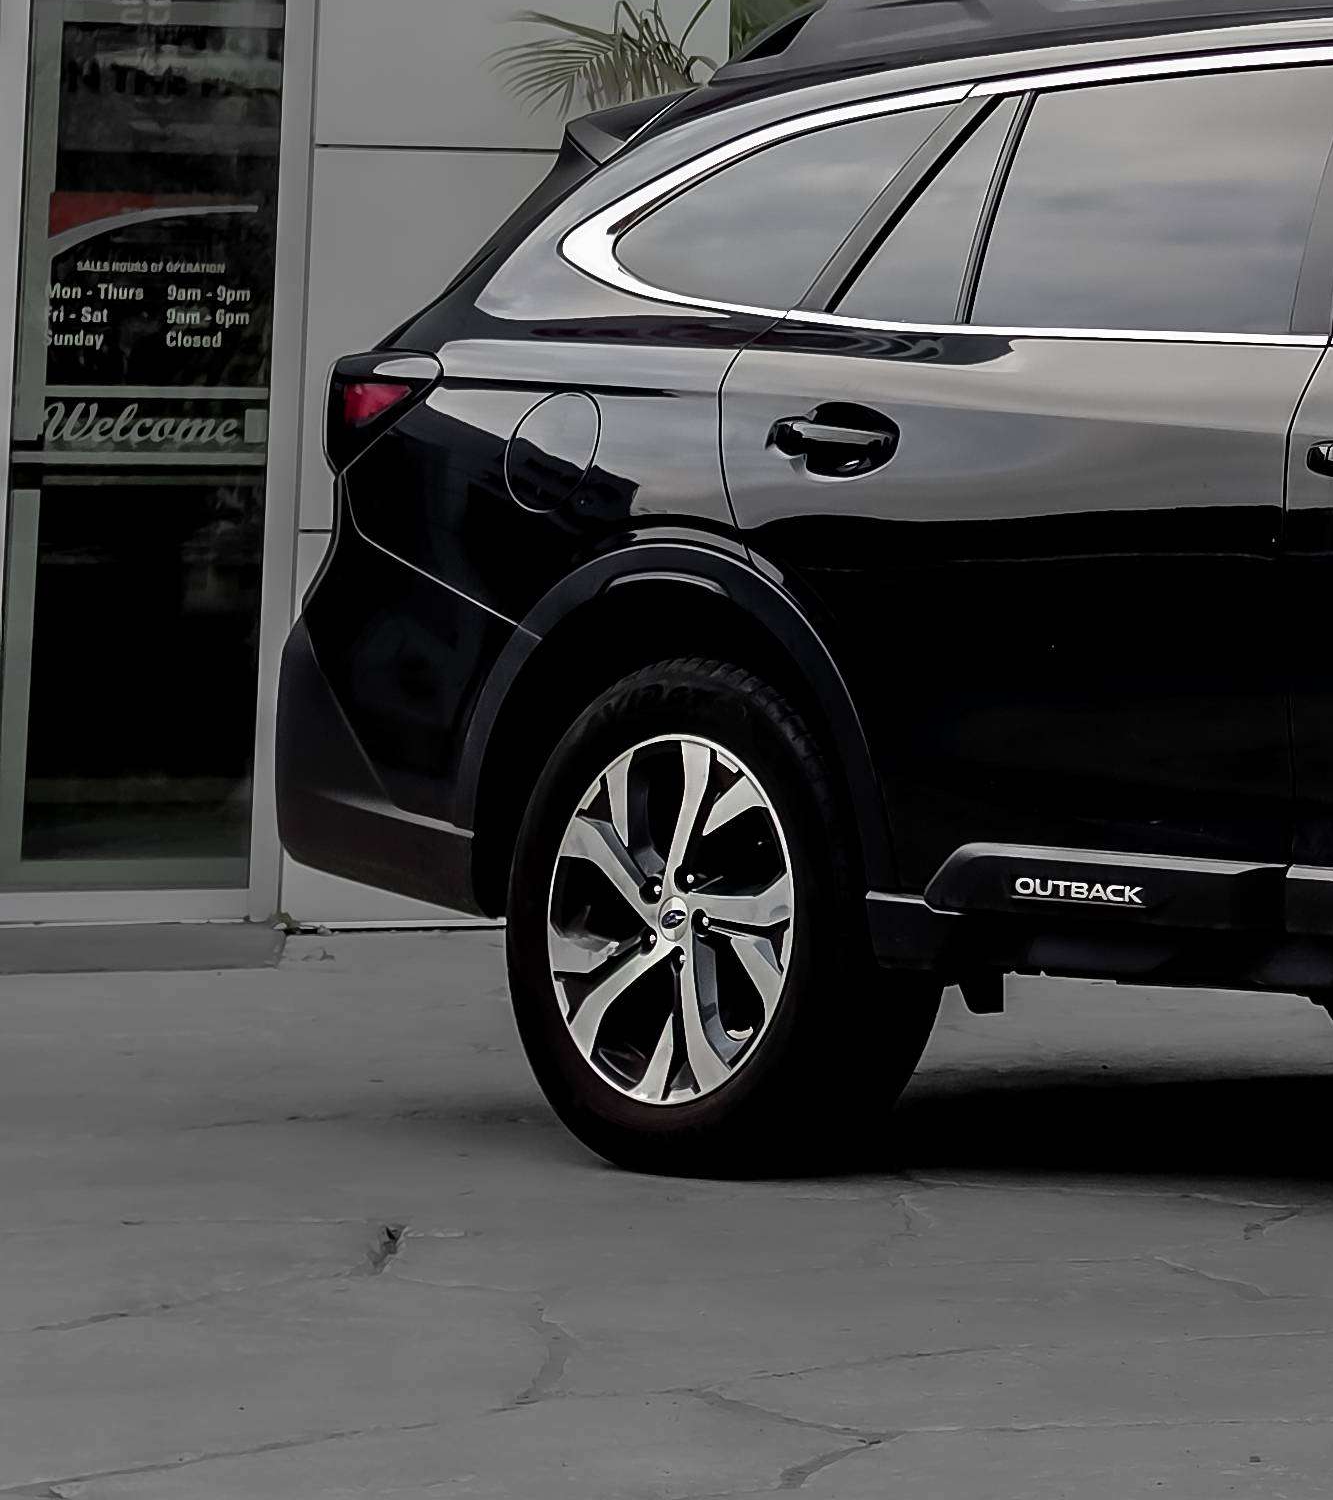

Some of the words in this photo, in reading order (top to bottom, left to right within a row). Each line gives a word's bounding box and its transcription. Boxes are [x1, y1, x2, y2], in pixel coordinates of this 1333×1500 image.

[76, 261, 110, 272] SALES
[111, 261, 148, 272] HOURS
[166, 262, 226, 273] OPERATION
[98, 283, 144, 300] Thurs
[167, 284, 201, 301] 9am
[216, 284, 250, 305] 9pm
[81, 306, 108, 323] Sat
[166, 307, 200, 325] 9am
[166, 331, 222, 348] Closed
[44, 402, 238, 443] Welcome
[1014, 876, 1144, 904] OUTBACK
